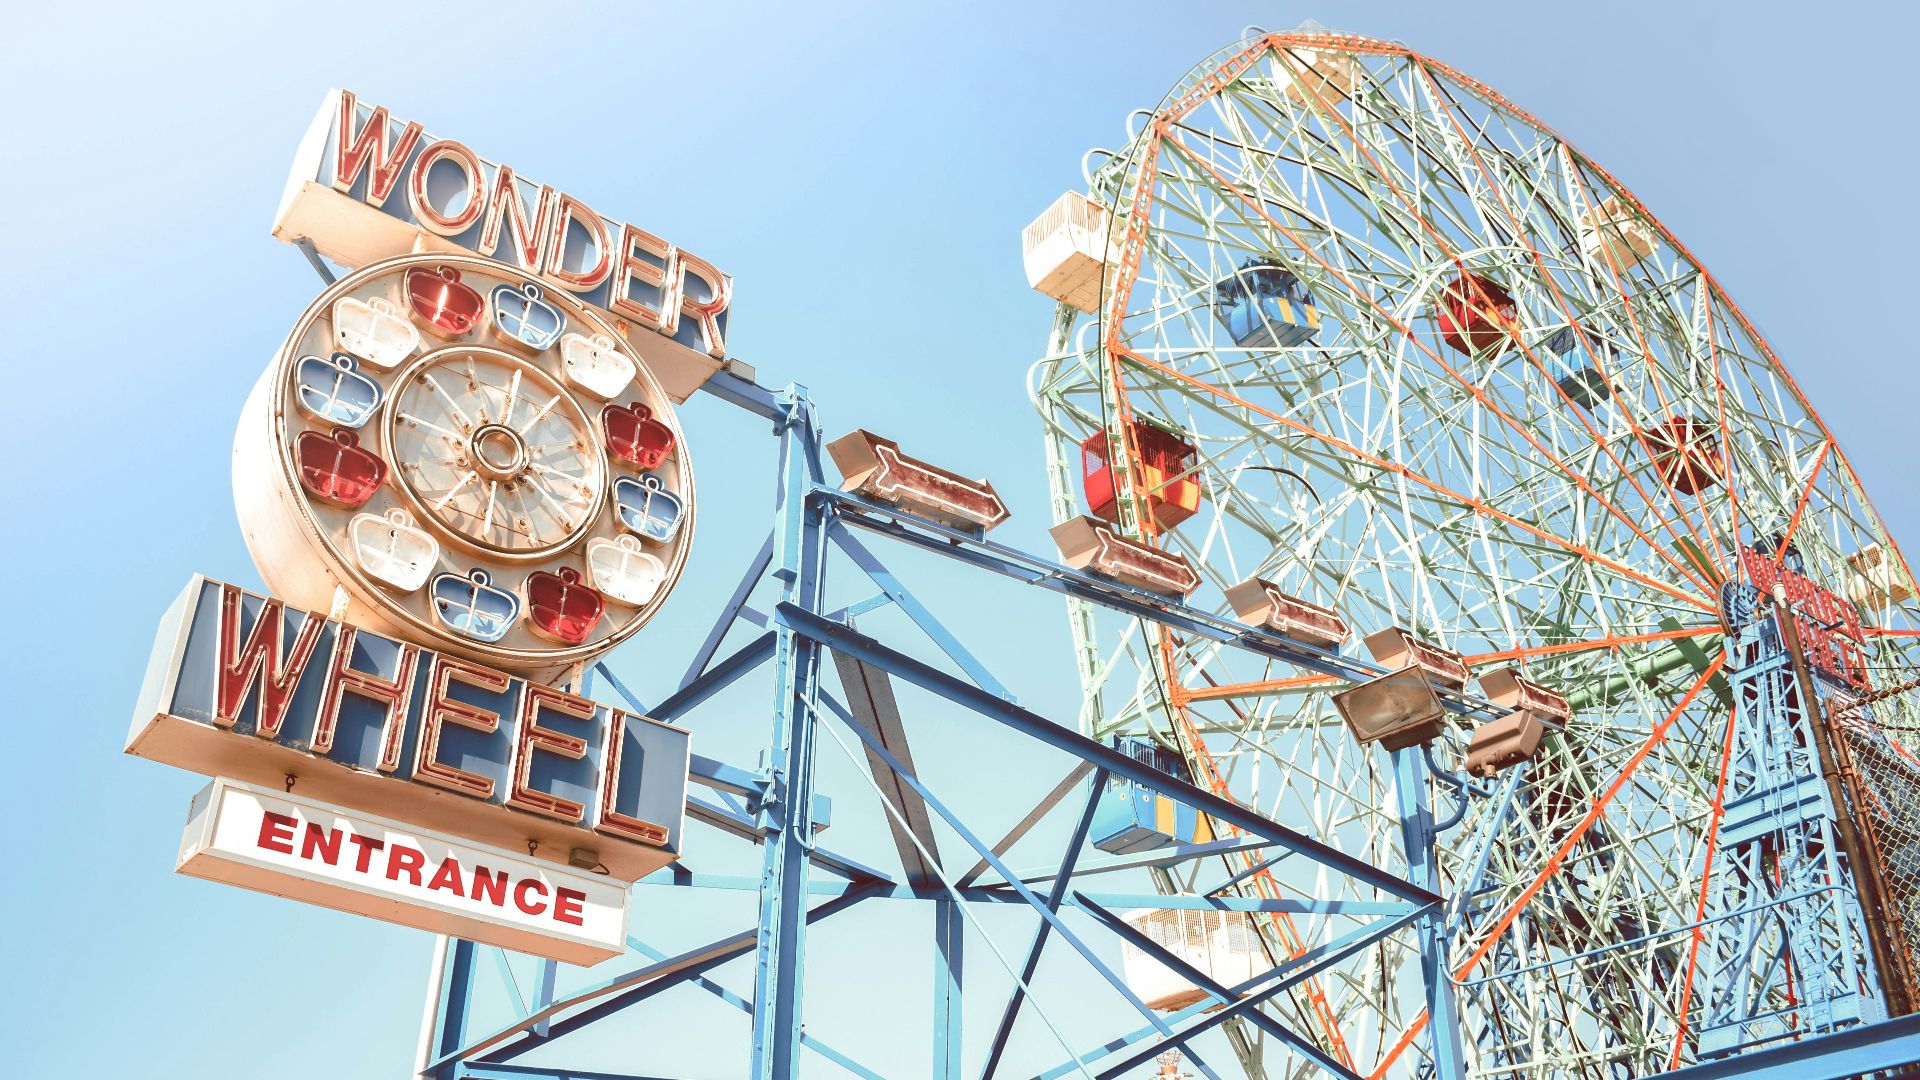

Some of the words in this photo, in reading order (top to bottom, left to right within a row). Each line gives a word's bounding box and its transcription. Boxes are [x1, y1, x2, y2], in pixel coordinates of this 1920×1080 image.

[333, 89, 731, 356] WONDER
[213, 583, 669, 846] WHEEL
[257, 811, 586, 926] ENTRANCE
